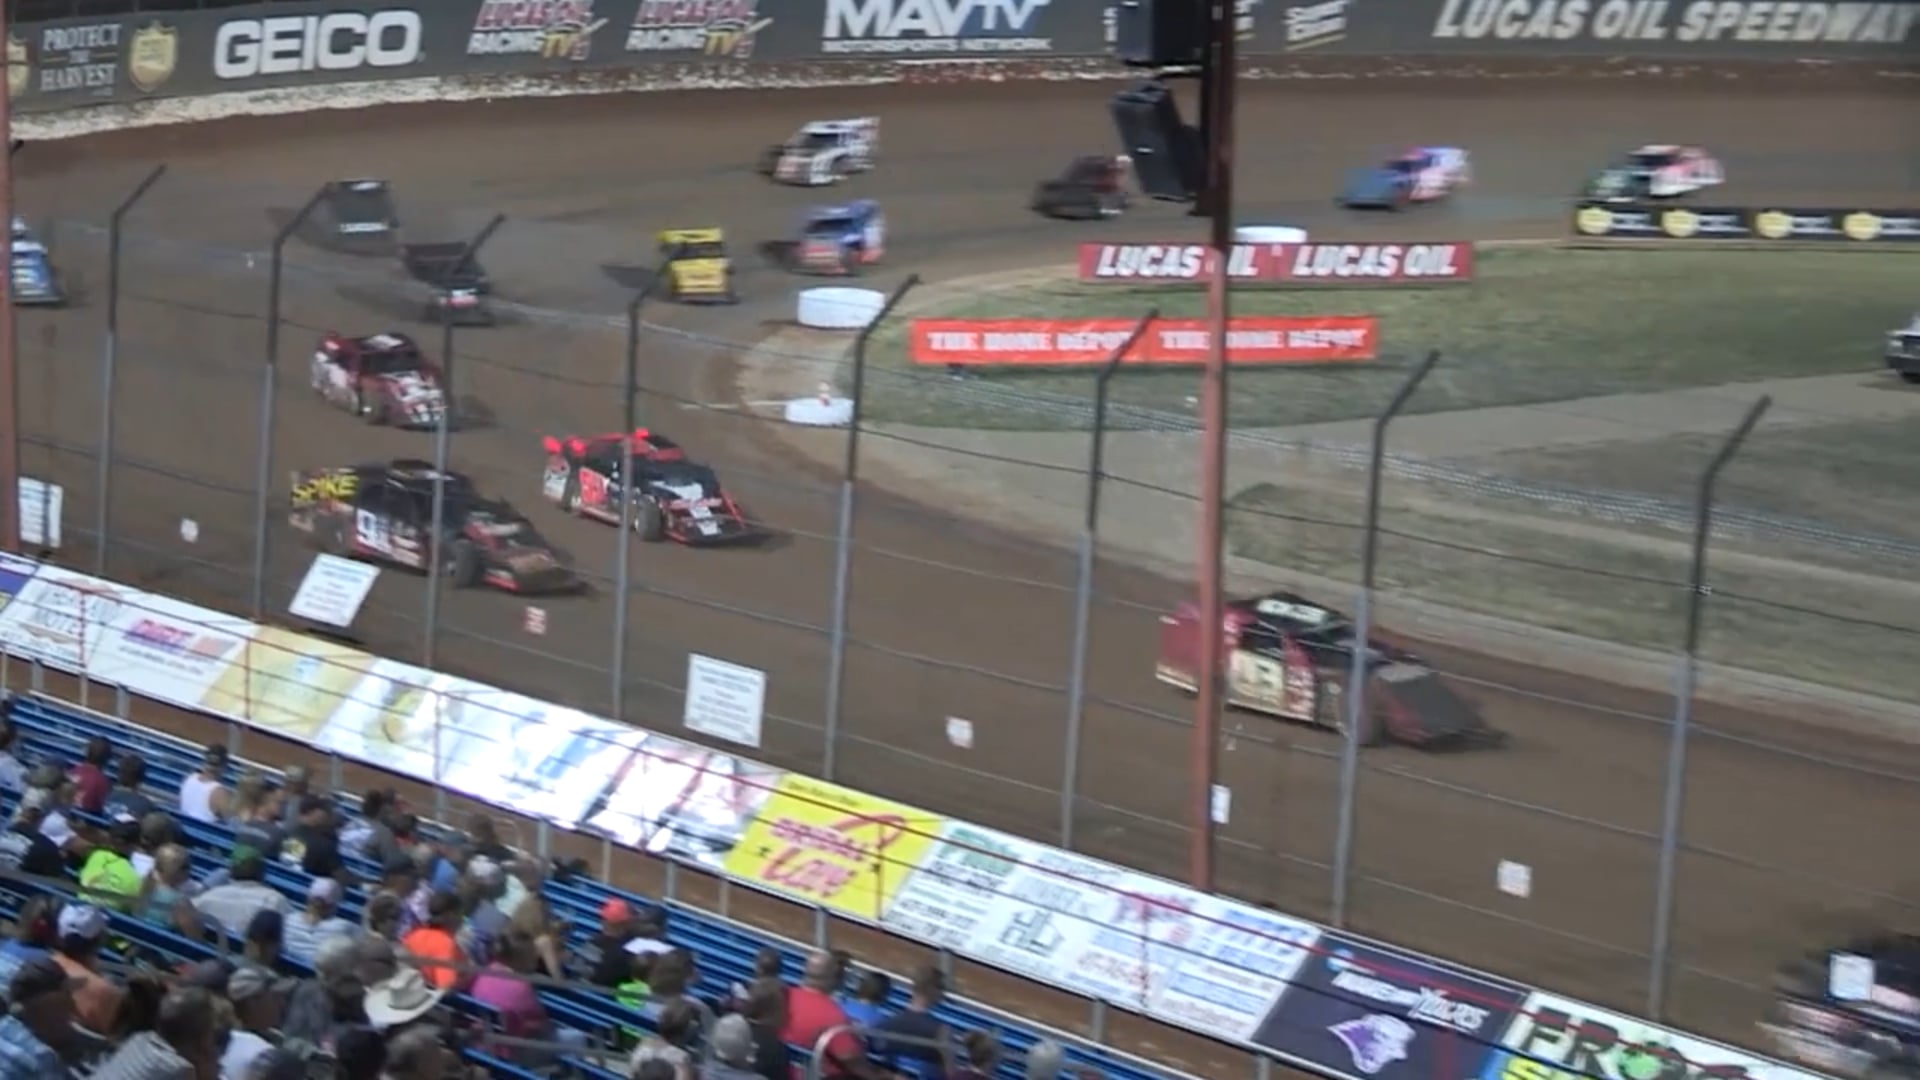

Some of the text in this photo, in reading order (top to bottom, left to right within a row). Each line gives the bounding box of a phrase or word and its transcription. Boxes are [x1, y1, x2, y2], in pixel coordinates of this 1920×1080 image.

[1433, 0, 1914, 42] LUCAS OIL SPEEDWAY
[43, 24, 122, 50] PROTECT
[213, 11, 420, 79] GEICO
[822, 37, 1052, 52] MOTORSPORTS NETWORK
[40, 63, 117, 91] HARVEST
[1096, 245, 1203, 277] LUCAS
[1292, 245, 1457, 277] LUCAS OIL
[928, 332, 978, 351] THE
[1158, 331, 1210, 349] THE
